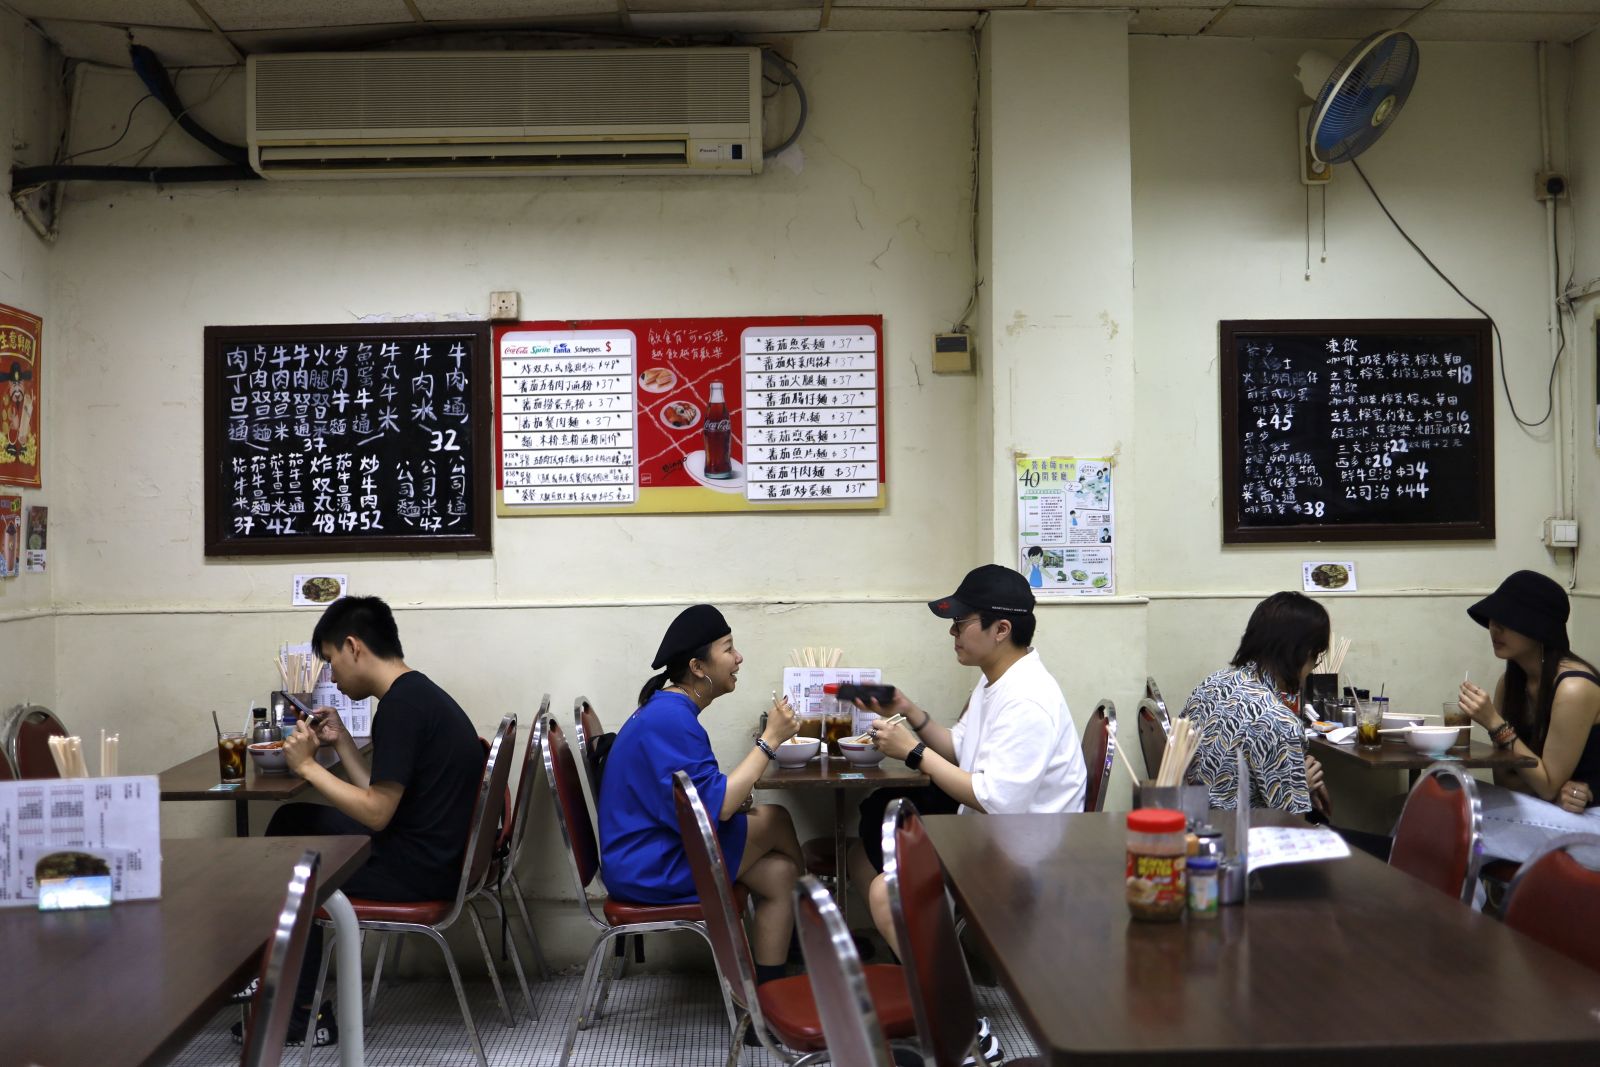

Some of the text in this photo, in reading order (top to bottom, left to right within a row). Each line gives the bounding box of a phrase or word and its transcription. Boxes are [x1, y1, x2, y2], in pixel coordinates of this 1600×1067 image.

[530, 345, 551, 354] Sprite
[553, 345, 571, 354] Fanta
[574, 344, 602, 353] Schweppes
[1446, 365, 1472, 384] $18
[1256, 414, 1293, 431] $45
[303, 438, 327, 453] 37
[429, 429, 461, 452] 32
[1382, 439, 1409, 453] $22
[1364, 452, 1393, 468] $26
[1019, 468, 1040, 488] 40
[1396, 461, 1429, 480] $34
[1396, 482, 1430, 499] $44
[1292, 501, 1325, 518] $38
[234, 516, 255, 535] 37
[266, 518, 297, 535] 42
[312, 514, 335, 534] 48
[338, 512, 359, 532] 47
[360, 510, 384, 530] 52
[420, 517, 442, 532] 47
